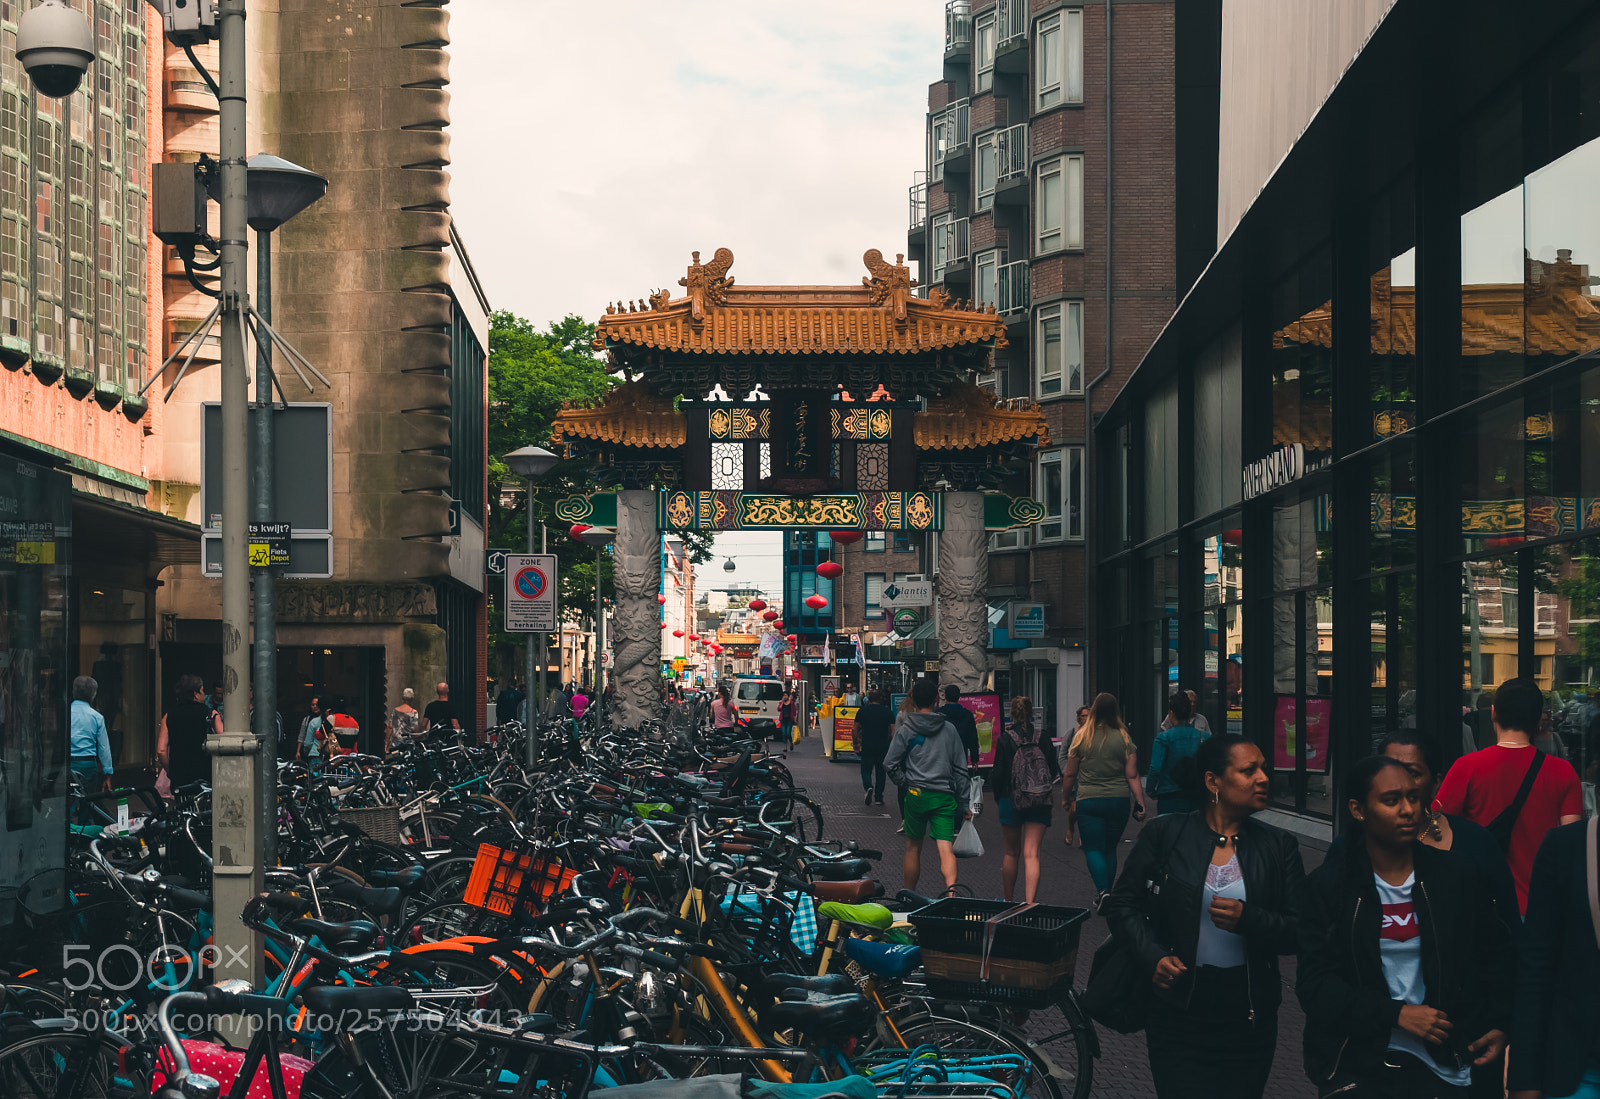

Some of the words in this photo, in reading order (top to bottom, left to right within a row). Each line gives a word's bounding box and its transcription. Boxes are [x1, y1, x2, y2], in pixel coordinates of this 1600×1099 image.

[1243, 458, 1267, 501] RIVER
[1266, 443, 1305, 492] ISLAND
[261, 524, 290, 534] kwijt?
